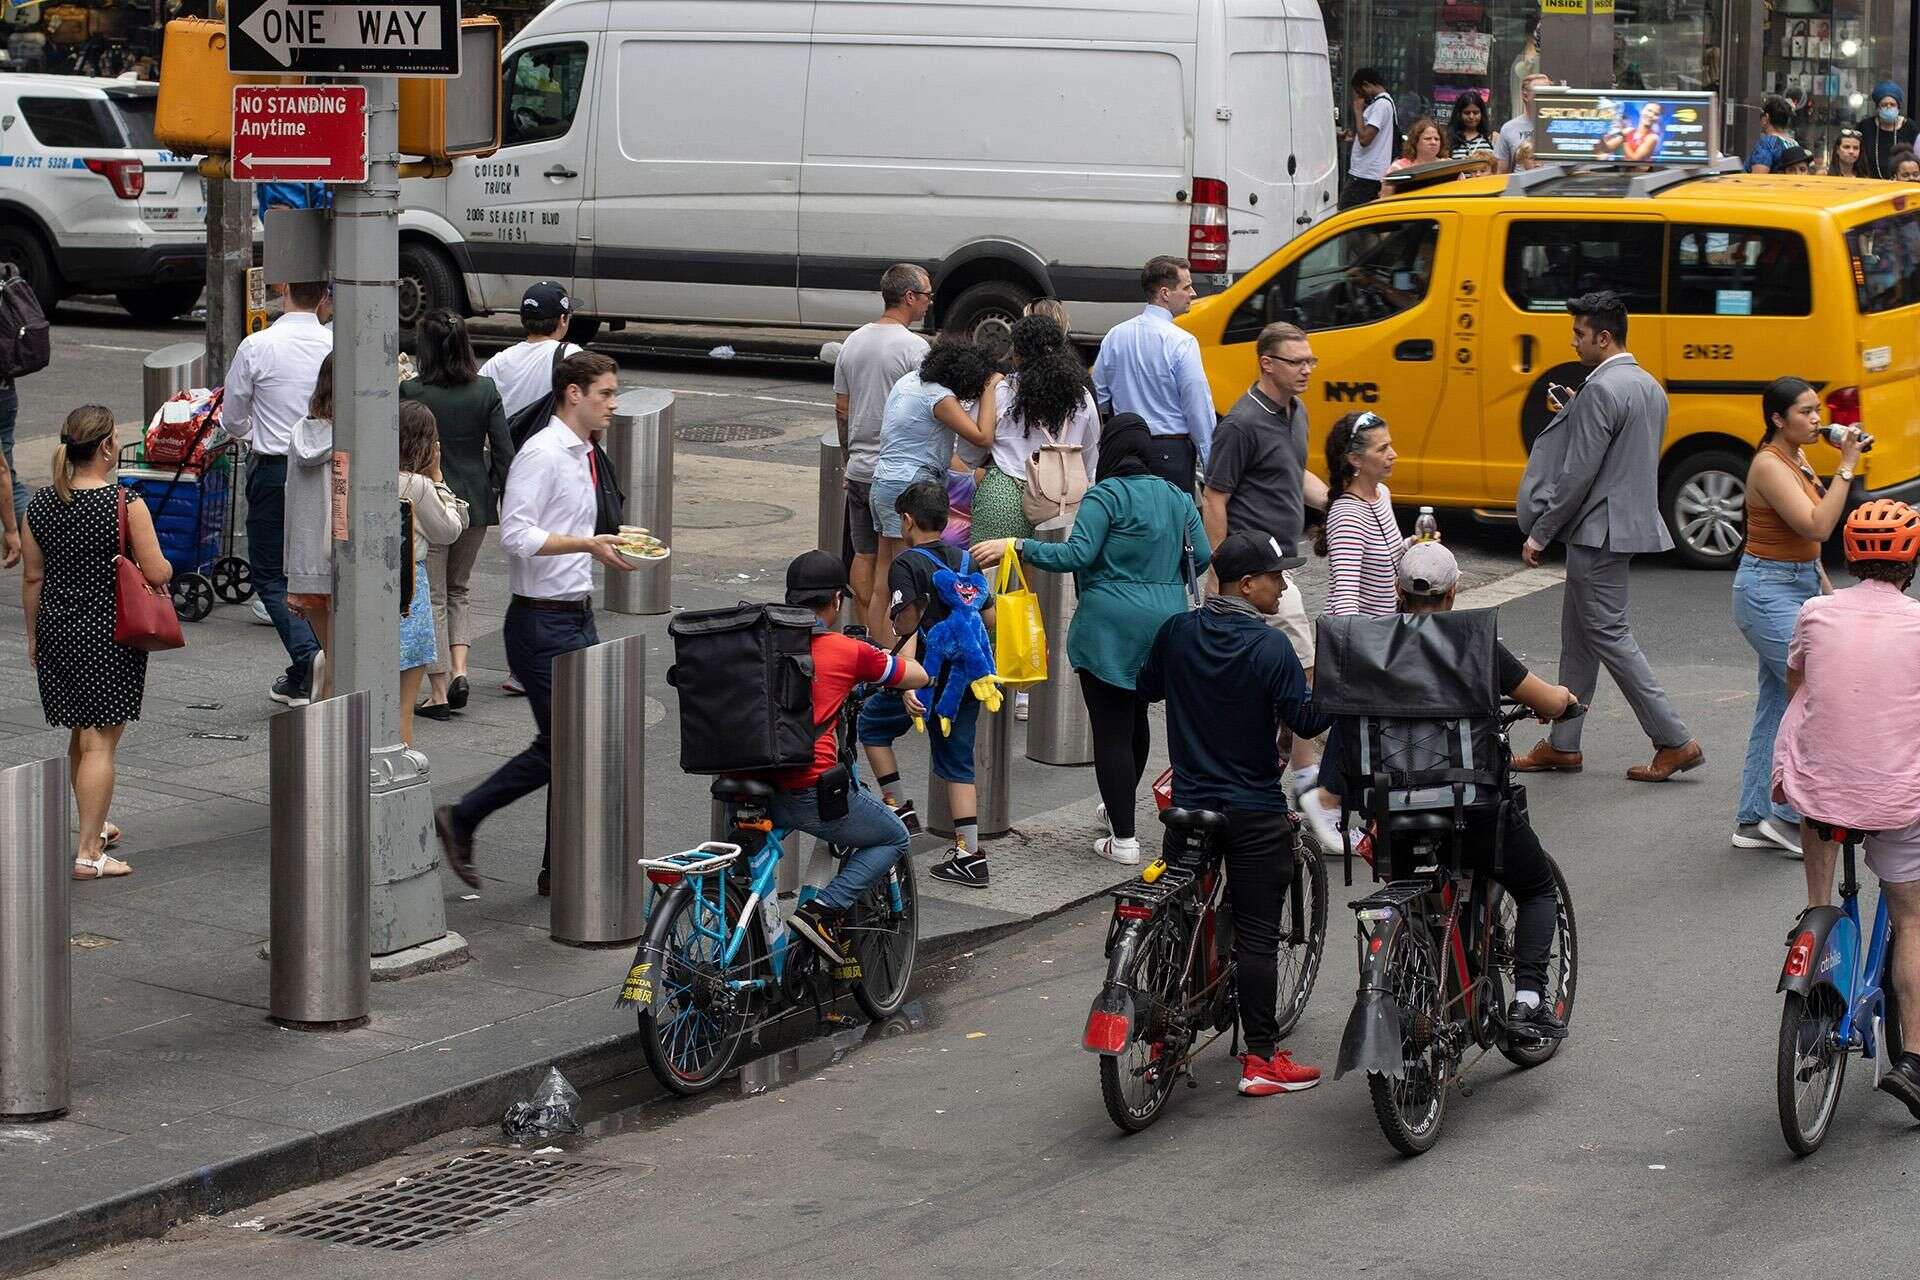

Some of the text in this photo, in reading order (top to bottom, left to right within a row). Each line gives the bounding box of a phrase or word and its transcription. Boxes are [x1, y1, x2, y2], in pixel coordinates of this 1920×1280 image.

[1545, 0, 1583, 8] INSIDE
[263, 9, 427, 45] ONE WAY
[240, 96, 347, 114] NO STANDING
[240, 118, 306, 140] Anytime
[27, 156, 43, 169] PCT
[484, 181, 512, 195] TRUCK
[466, 207, 560, 226] 2006 SEAGIRT BLVD
[498, 226, 528, 243] 11691
[1682, 343, 1734, 361] 2N32
[1323, 380, 1380, 404] NYC
